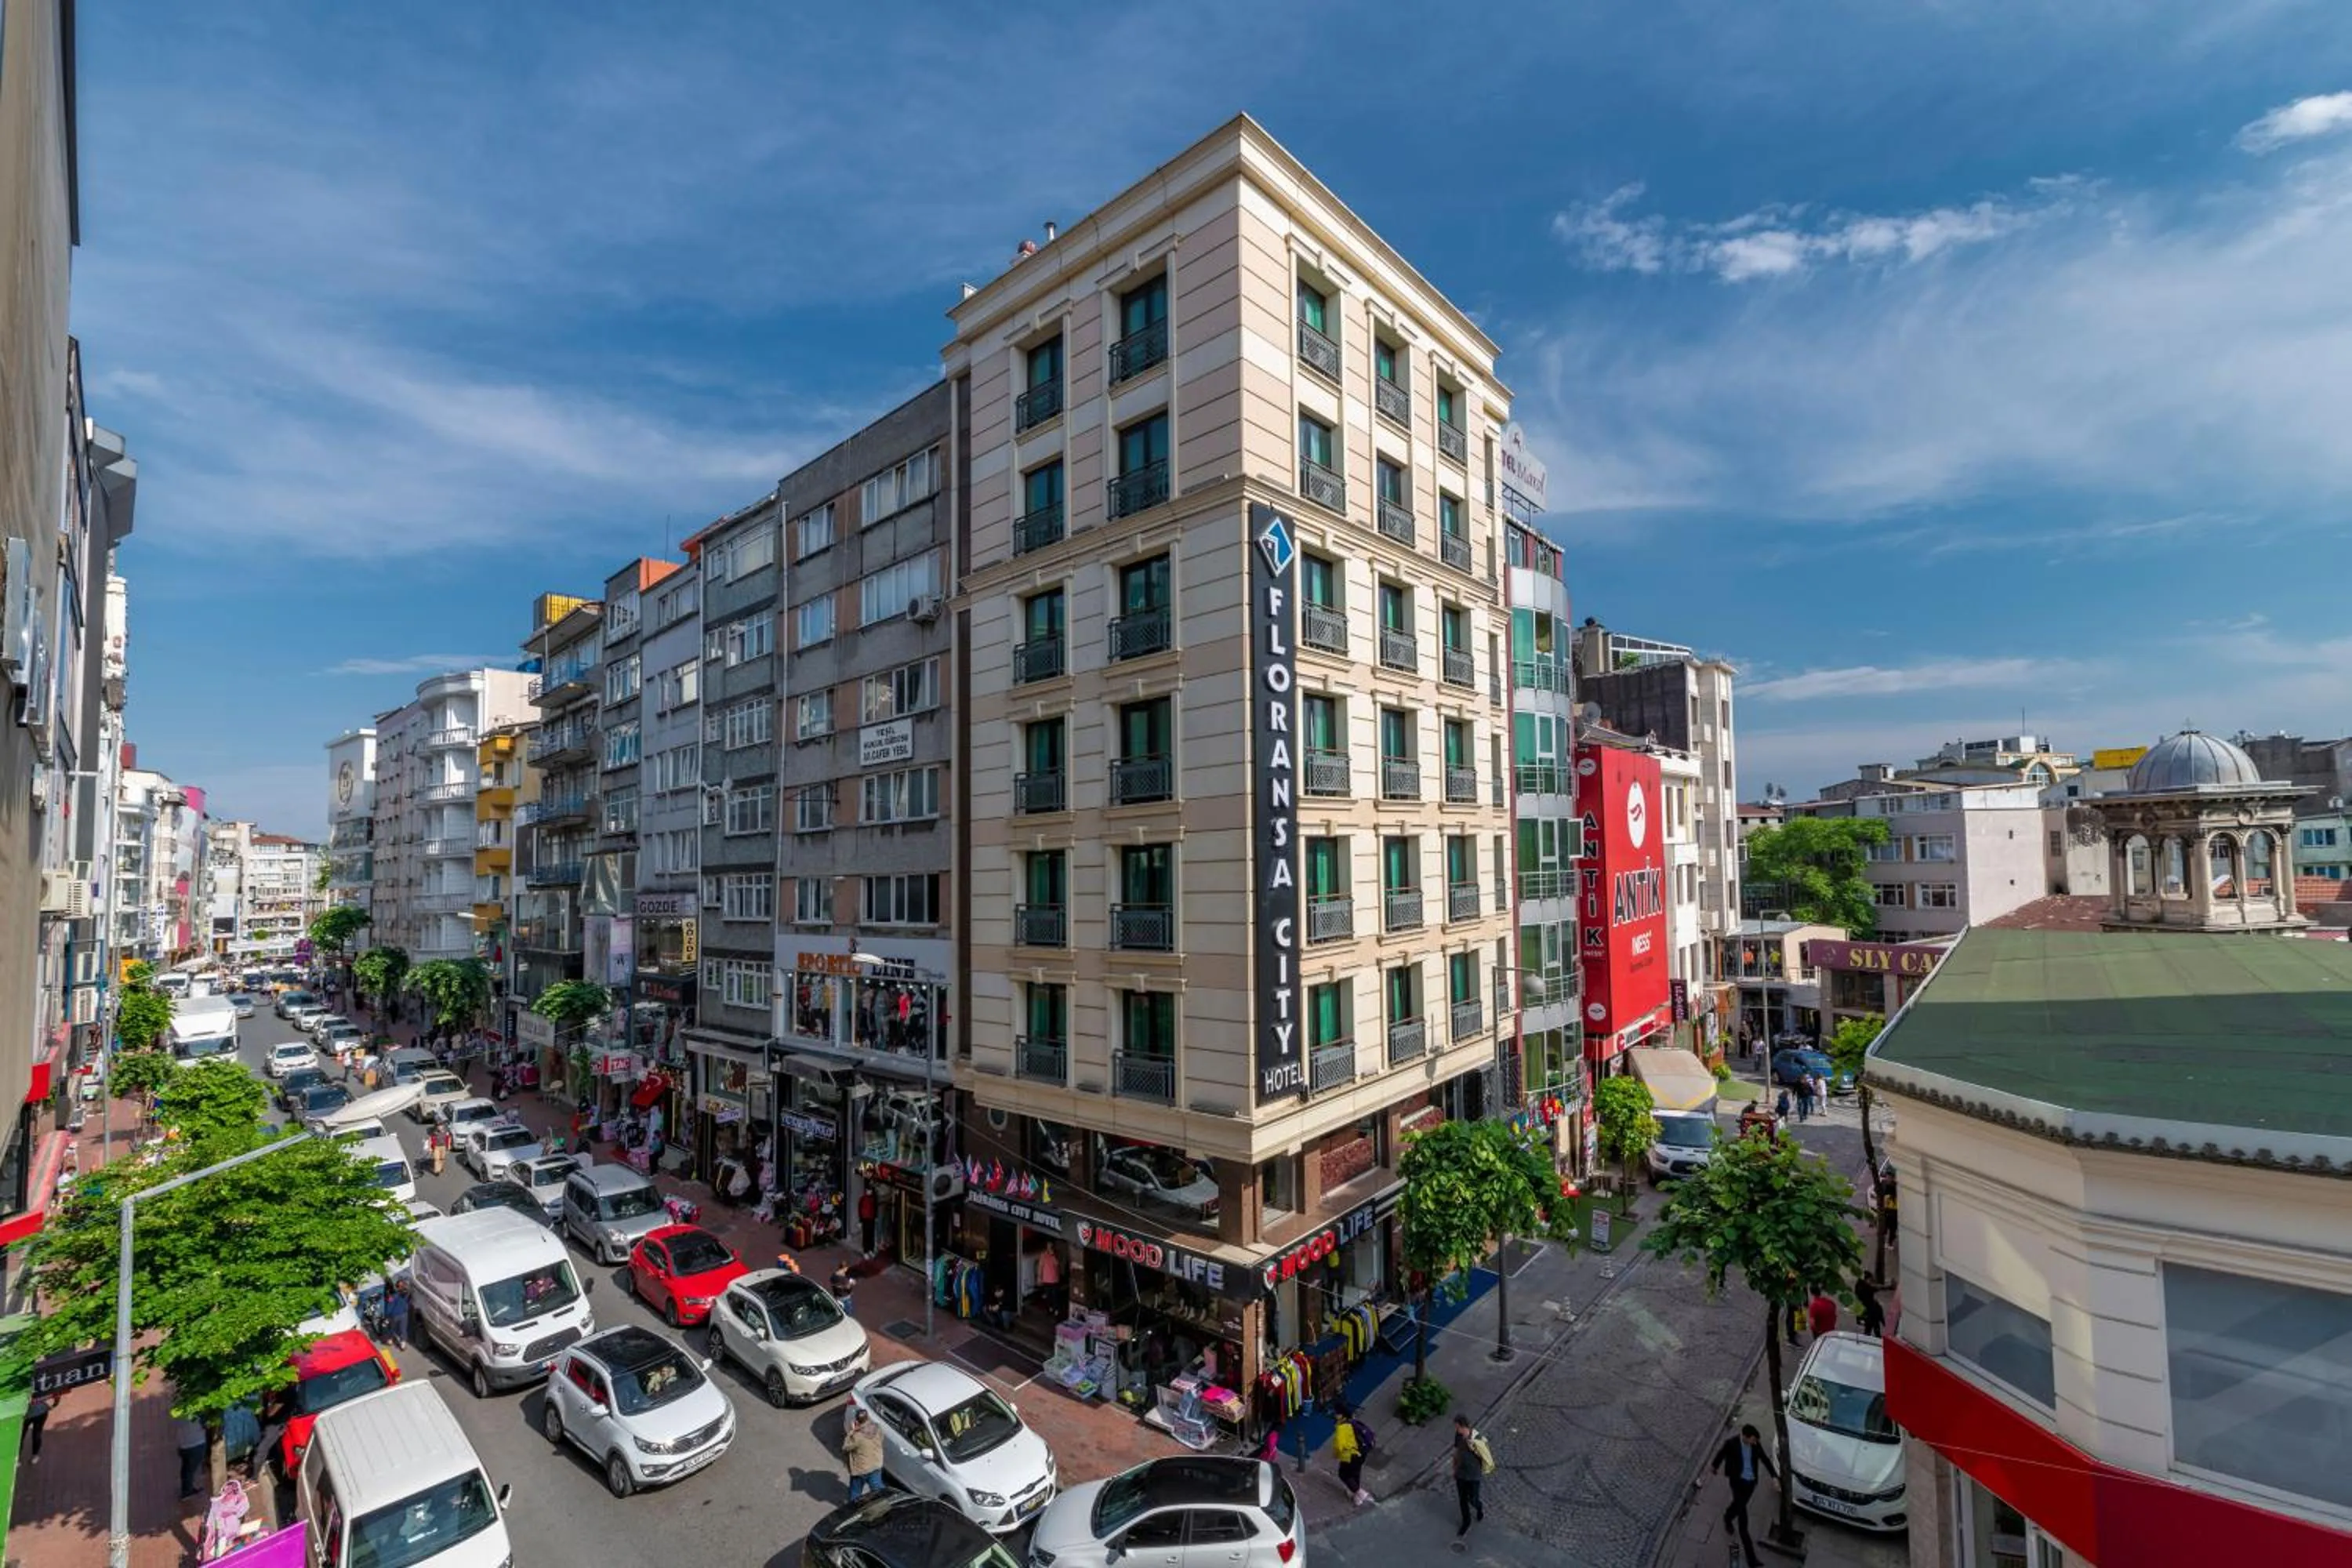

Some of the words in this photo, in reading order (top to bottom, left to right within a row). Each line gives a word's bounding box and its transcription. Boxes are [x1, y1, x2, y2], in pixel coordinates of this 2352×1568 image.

[1268, 586, 1293, 888] FLORANSA
[871, 957, 916, 979] LINE
[1275, 917, 1293, 1054] CITY
[1849, 948, 1893, 970] SLY
[1265, 1062, 1304, 1094] HOTEL
[1096, 1228, 1163, 1268] MOOD
[1167, 1250, 1225, 1290] LIFE
[1280, 1230, 1336, 1280] MOOD
[1337, 1206, 1374, 1245] LIFE
